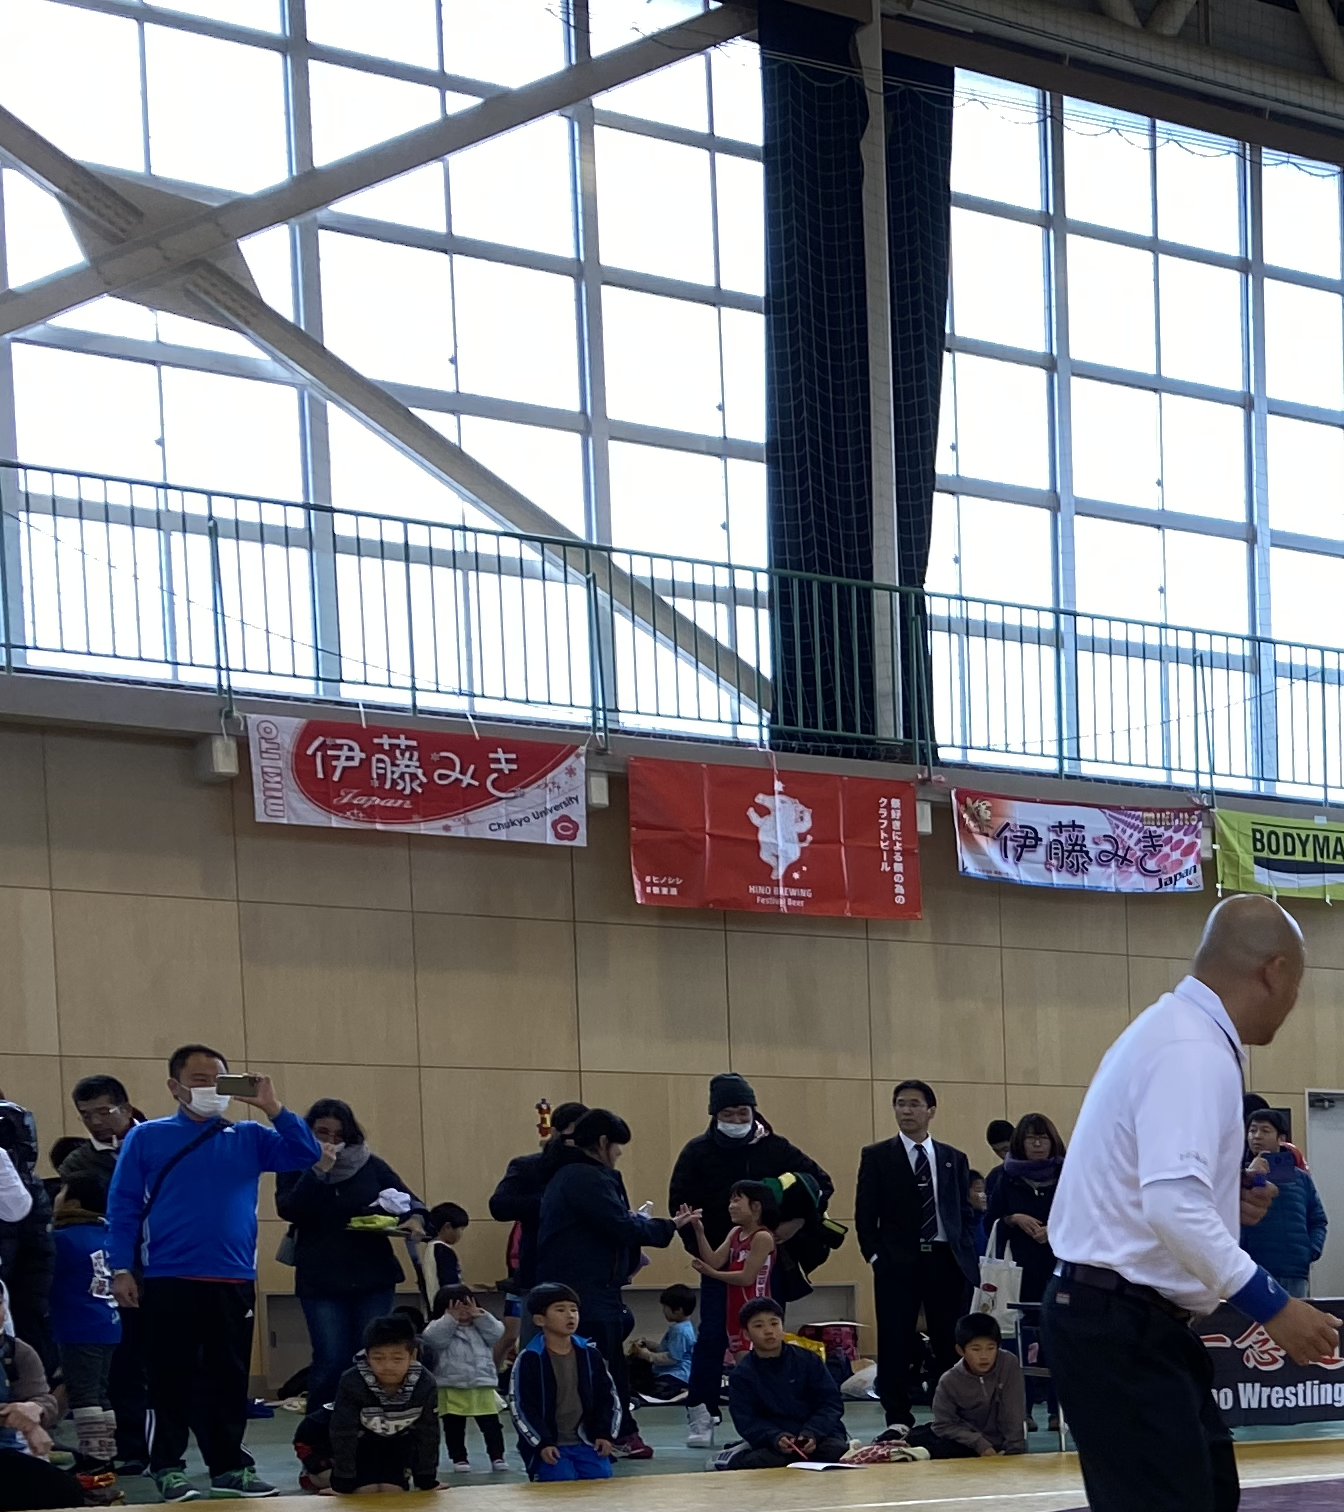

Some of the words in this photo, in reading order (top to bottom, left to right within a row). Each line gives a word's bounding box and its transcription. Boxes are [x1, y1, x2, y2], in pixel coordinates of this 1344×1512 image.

[257, 719, 281, 761] ITO
[306, 734, 519, 799] 伊藤みき
[261, 765, 286, 818] MIKI
[333, 788, 412, 809] Japan
[488, 815, 531, 832] Chukyo
[532, 795, 579, 820] University
[878, 797, 891, 872] クラフトビール
[994, 819, 1164, 874] 伊藤みき
[1155, 865, 1197, 890] Japan
